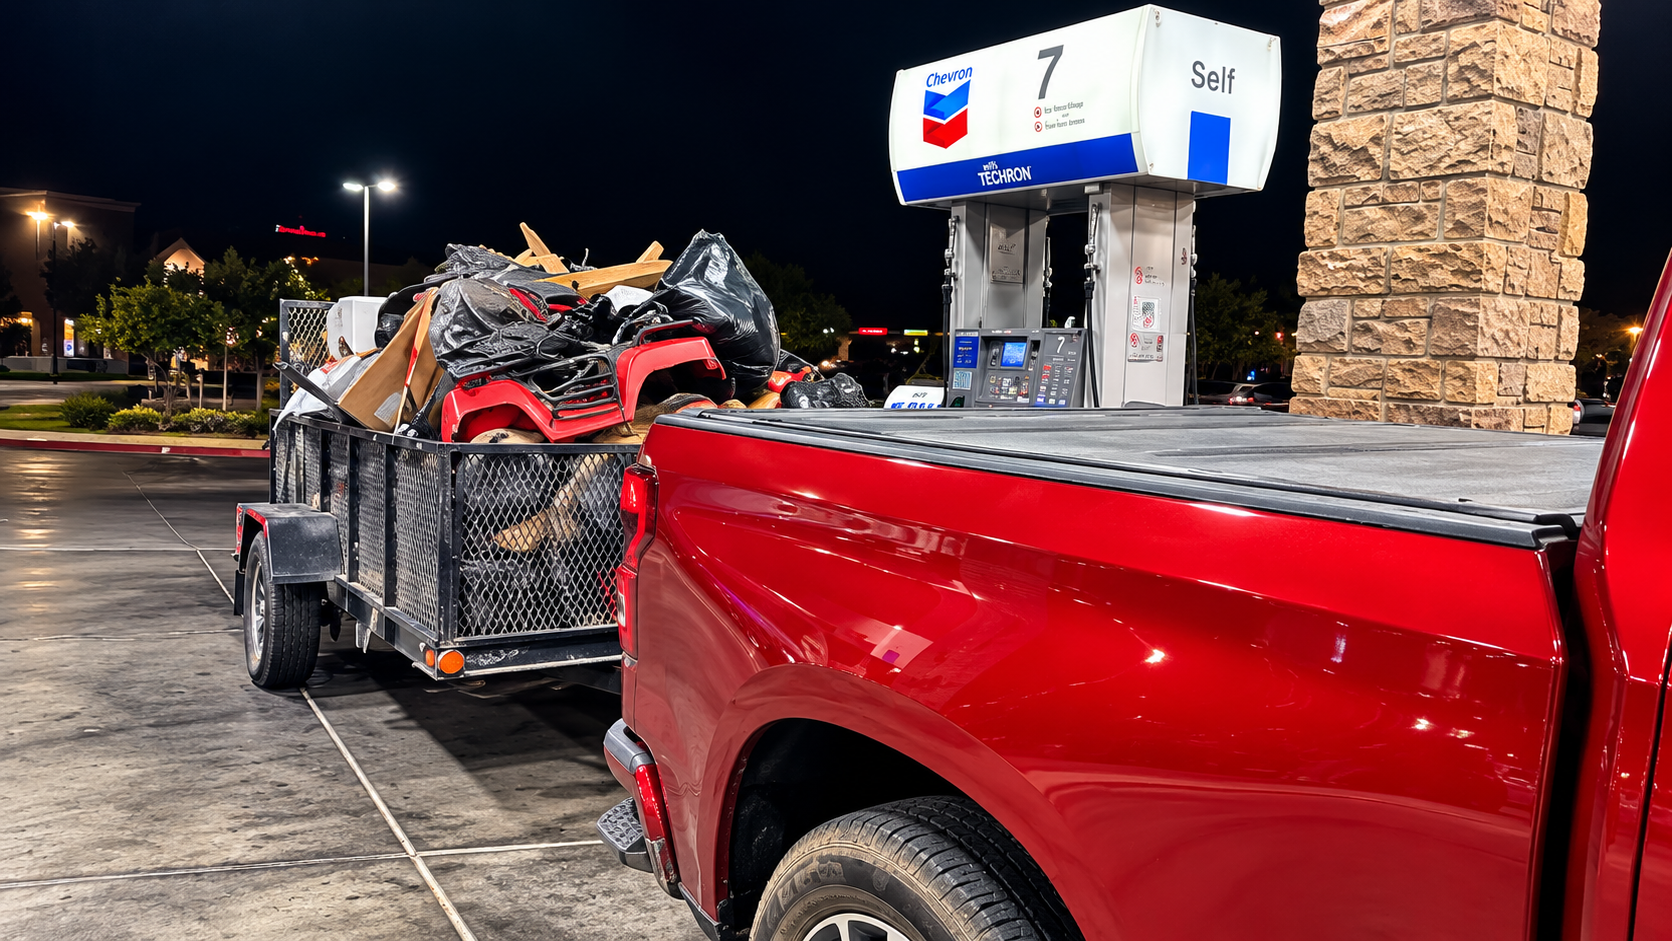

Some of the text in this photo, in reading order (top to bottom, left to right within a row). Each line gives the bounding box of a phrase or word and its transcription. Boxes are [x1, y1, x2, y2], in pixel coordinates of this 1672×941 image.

[926, 66, 973, 88] Chevron
[1037, 44, 1064, 100] 7
[1191, 60, 1236, 94] Self
[977, 165, 1032, 186] TECHRON
[1057, 336, 1066, 354] 7
